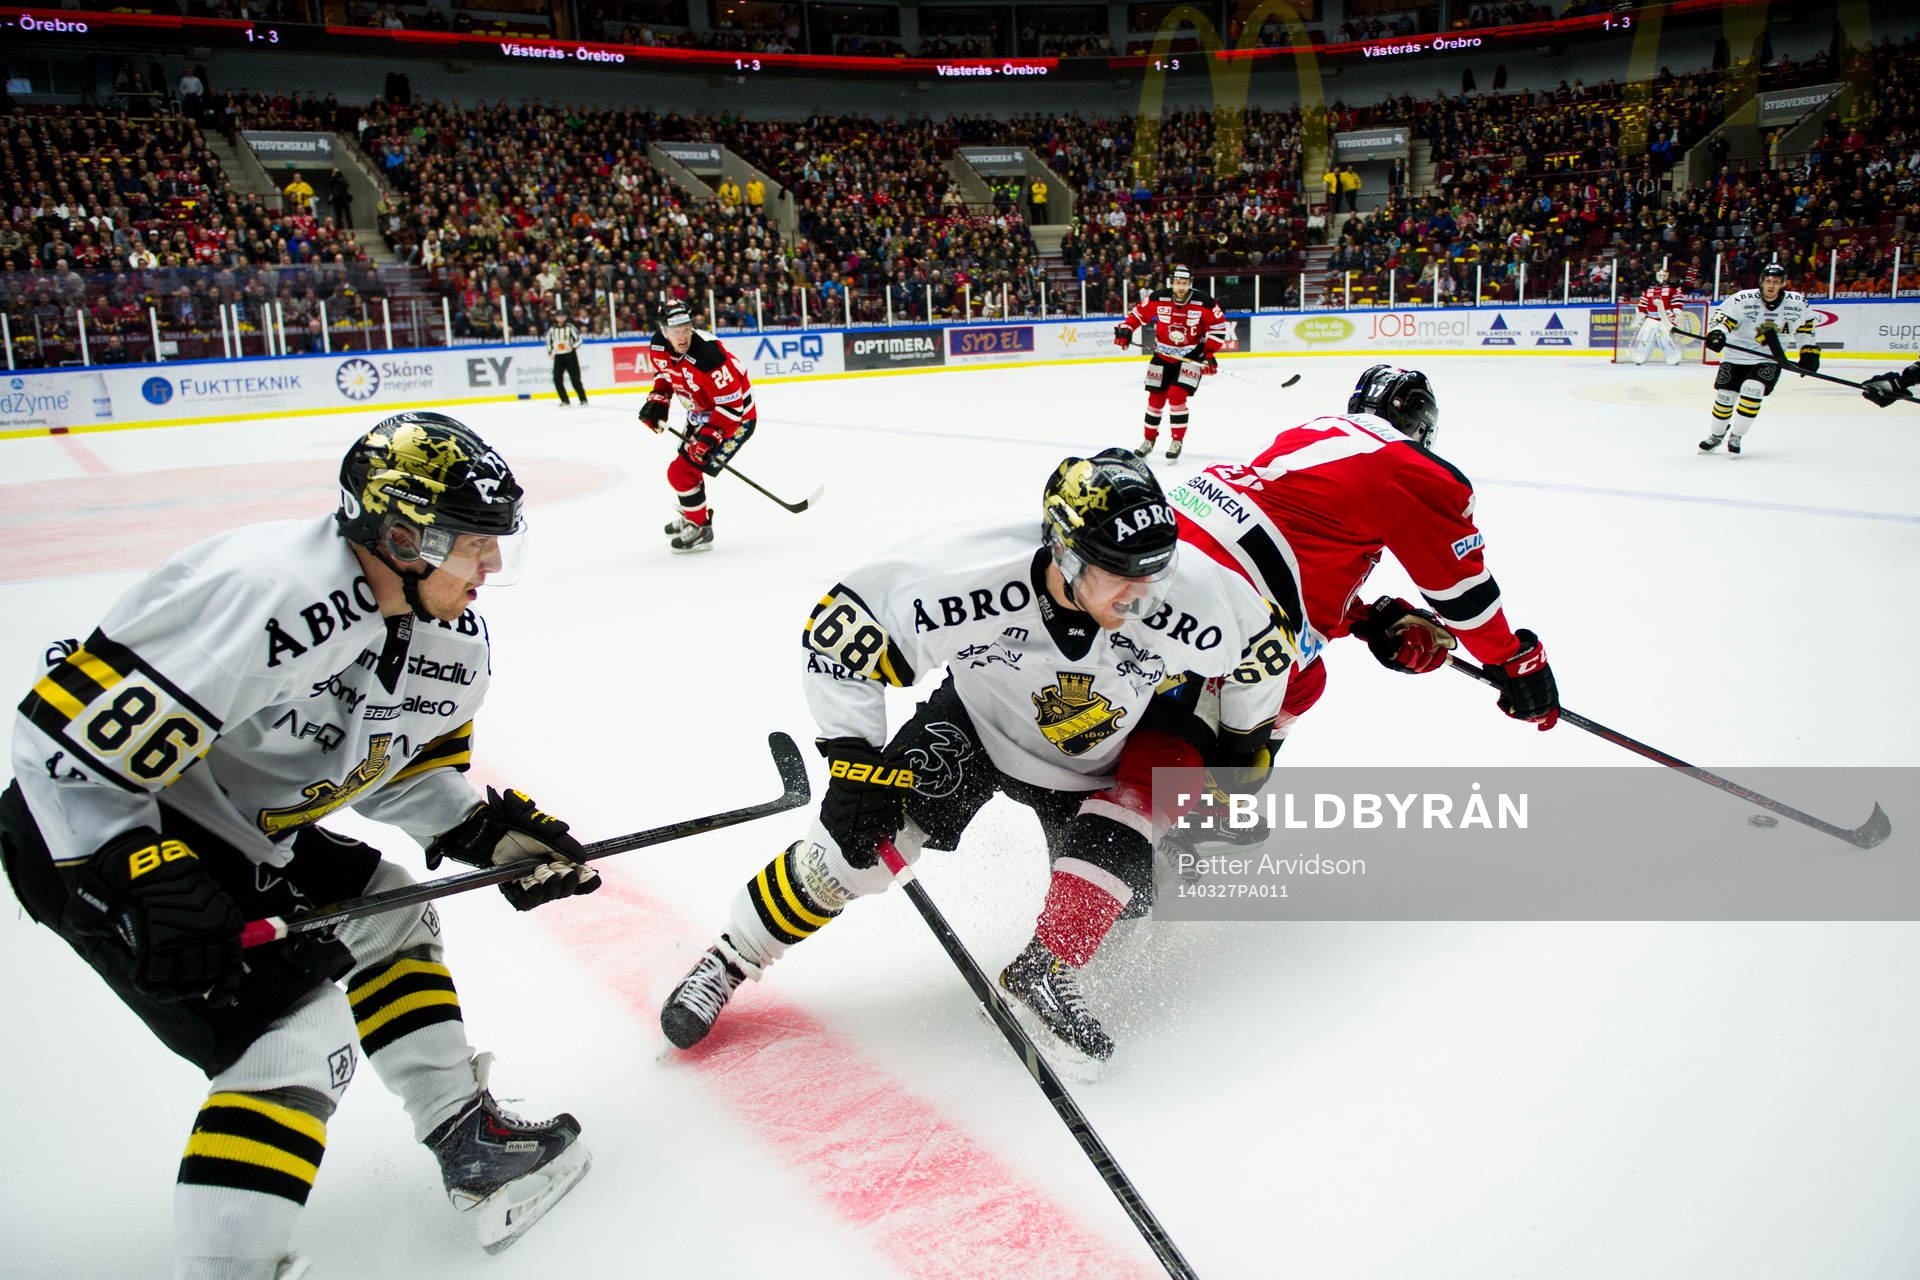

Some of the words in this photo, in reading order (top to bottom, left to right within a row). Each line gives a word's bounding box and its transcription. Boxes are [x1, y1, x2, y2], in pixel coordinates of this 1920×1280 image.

[20, 14, 88, 33] Örebro
[501, 43, 565, 59] Västerås
[576, 46, 625, 63] Örebro
[1363, 41, 1421, 58] Västerås
[1433, 37, 1482, 51] Örebro
[937, 64, 993, 76] Västerås
[1003, 63, 1047, 76] Örebro
[252, 140, 316, 151] YDSVENSKAN
[754, 335, 824, 363] APQ
[854, 338, 935, 355] OPTIMERA
[382, 361, 434, 378] Skåne
[467, 356, 513, 387] EY
[711, 365, 734, 390] 24
[181, 375, 302, 397] FUKTTEKNIK
[1367, 383, 1385, 397] 17
[1114, 504, 1176, 543] ÅBRO
[914, 580, 1031, 634] ÅBRO
[265, 576, 380, 668] ÅBRO
[1067, 627, 1086, 637] SHL
[1143, 602, 1223, 651] BRO
[813, 604, 884, 673] 68
[407, 652, 477, 686] stadiu
[1232, 639, 1292, 684] 68
[85, 684, 201, 783] 86
